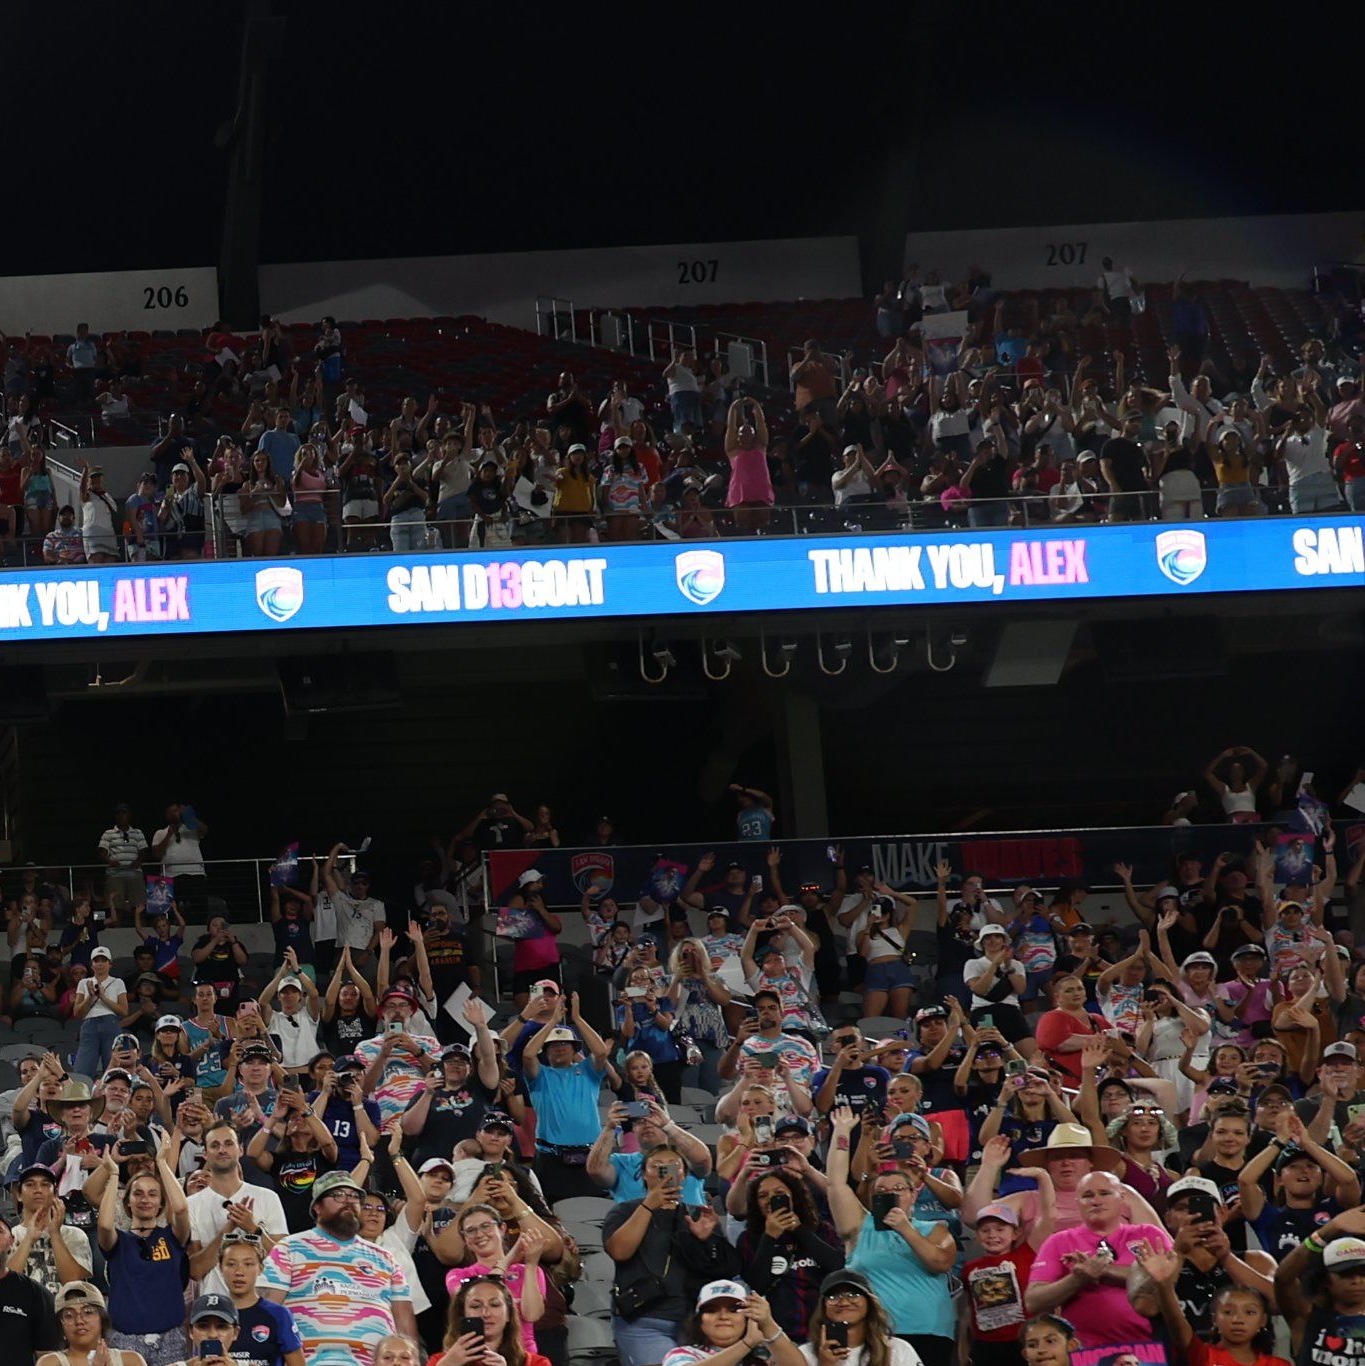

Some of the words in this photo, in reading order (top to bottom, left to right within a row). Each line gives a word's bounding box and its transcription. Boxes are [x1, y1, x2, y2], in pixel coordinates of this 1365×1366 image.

[1046, 242, 1088, 267] 207
[677, 259, 719, 284] 207
[143, 285, 190, 309] 206
[1294, 527, 1364, 575] SAN
[809, 546, 925, 593] THANK
[927, 544, 1004, 594] YOU,
[1010, 540, 1088, 585] ALEX
[387, 565, 460, 613] SAN
[463, 559, 606, 609] D13GOAT
[35, 581, 109, 631] YOU,
[114, 577, 189, 622] ALEX
[871, 842, 950, 888] MAKE
[196, 1051, 222, 1076] 23
[333, 1119, 350, 1137] 13
[229, 1351, 250, 1359] AISER
